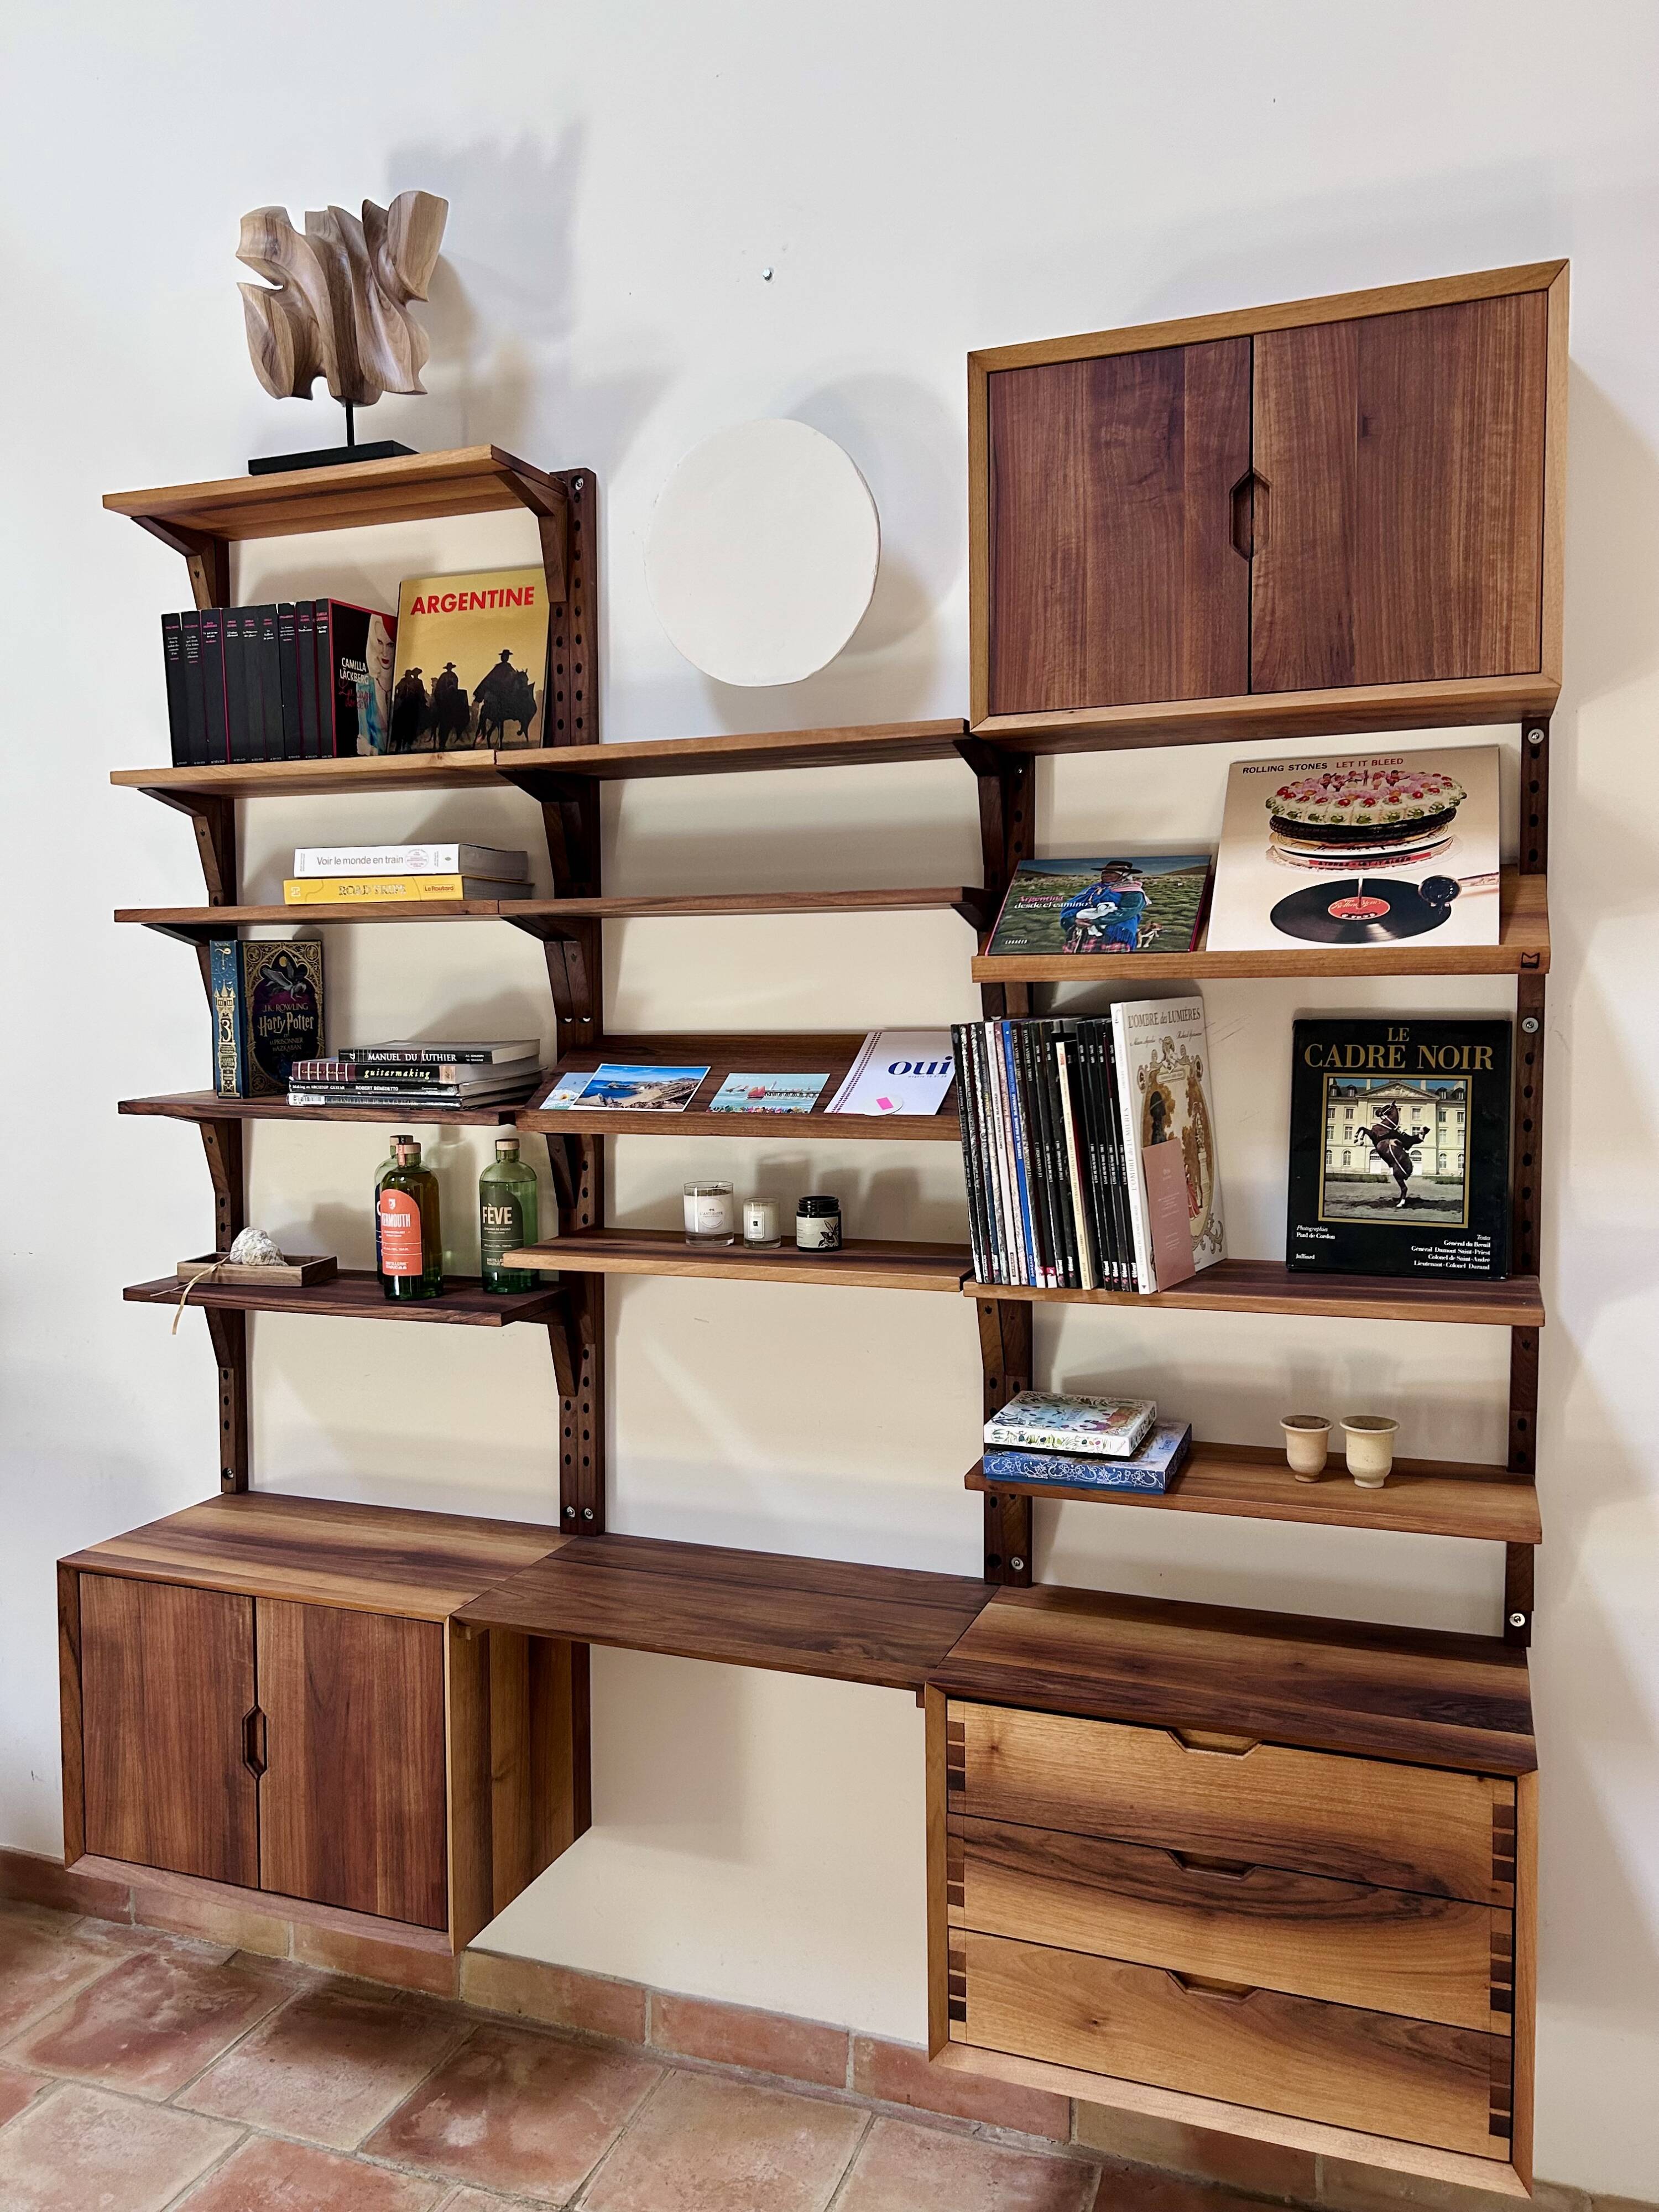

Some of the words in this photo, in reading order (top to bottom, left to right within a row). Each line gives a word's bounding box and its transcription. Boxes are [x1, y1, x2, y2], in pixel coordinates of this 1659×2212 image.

[410, 586, 535, 615] ARGENTINE
[342, 657, 366, 672] CAMILLA
[340, 667, 369, 685] LÄCKBERG
[1243, 765, 1284, 774] ROLLING
[1288, 763, 1327, 771] STONES
[316, 857, 332, 866] Voir
[334, 857, 341, 865] le
[342, 856, 371, 865] monde
[338, 885, 371, 895] ROAD
[373, 885, 406, 895] TRIPS
[276, 1003, 308, 1013] ROWLING
[257, 1015, 285, 1037] Harry
[286, 1011, 314, 1036] Potter
[1128, 1013, 1159, 1029] L'OMBRE
[1168, 1006, 1201, 1023] LUMIÈRES
[221, 1019, 232, 1042] 3
[1387, 1027, 1410, 1042] LE
[368, 1053, 401, 1061] MANUEL
[422, 1053, 457, 1062] LUTHIER
[1304, 1044, 1407, 1068] CADRE
[1417, 1045, 1493, 1070] NOIR
[364, 1068, 430, 1079] guitarmaking
[888, 1056, 953, 1076] oui
[382, 1212, 411, 1227] VERMOUTH
[482, 1203, 513, 1224] FÈVE
